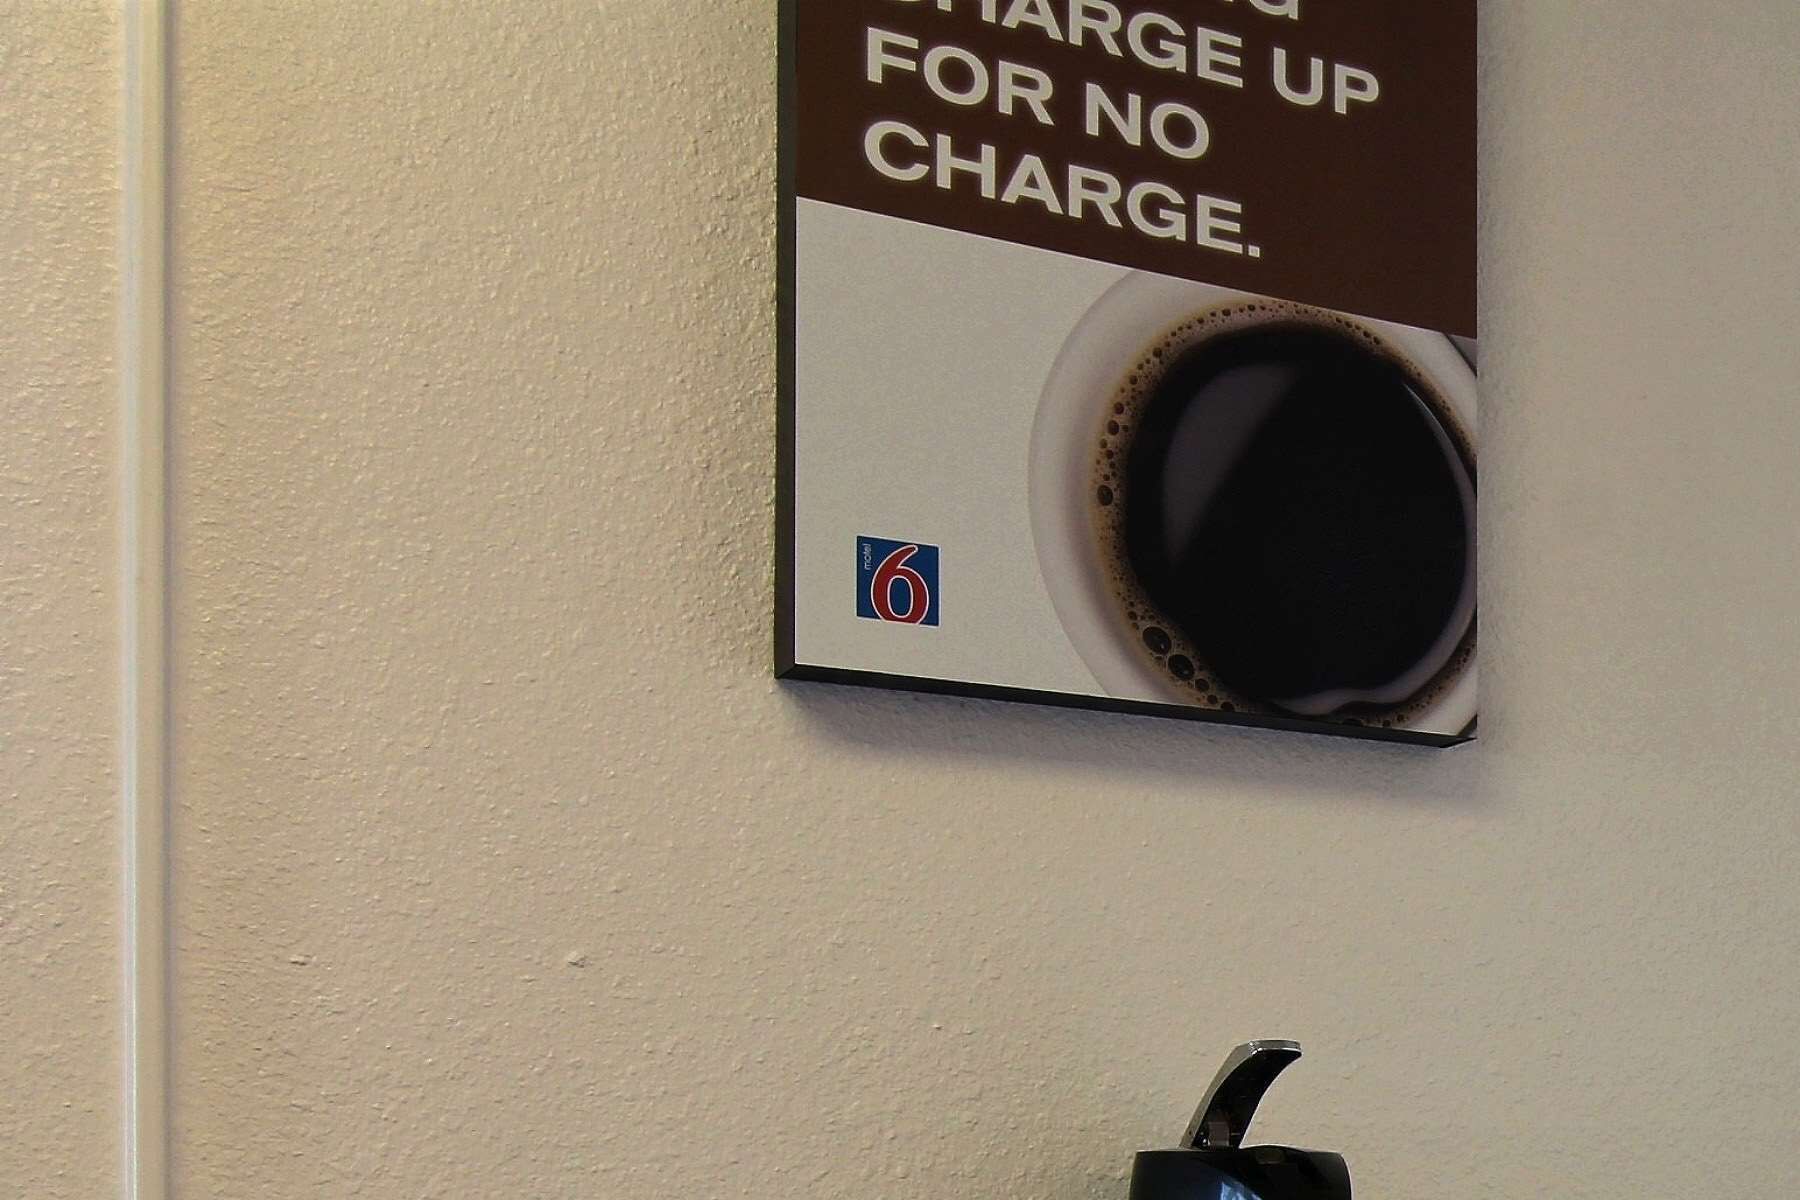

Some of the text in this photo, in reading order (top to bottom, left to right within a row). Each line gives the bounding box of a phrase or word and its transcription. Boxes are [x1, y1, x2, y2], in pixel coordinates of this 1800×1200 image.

[866, 27, 1210, 160] FOR NO
[896, 0, 1380, 115] ARGE UP
[863, 120, 1261, 258] CHARGE.
[870, 544, 930, 625] 6
